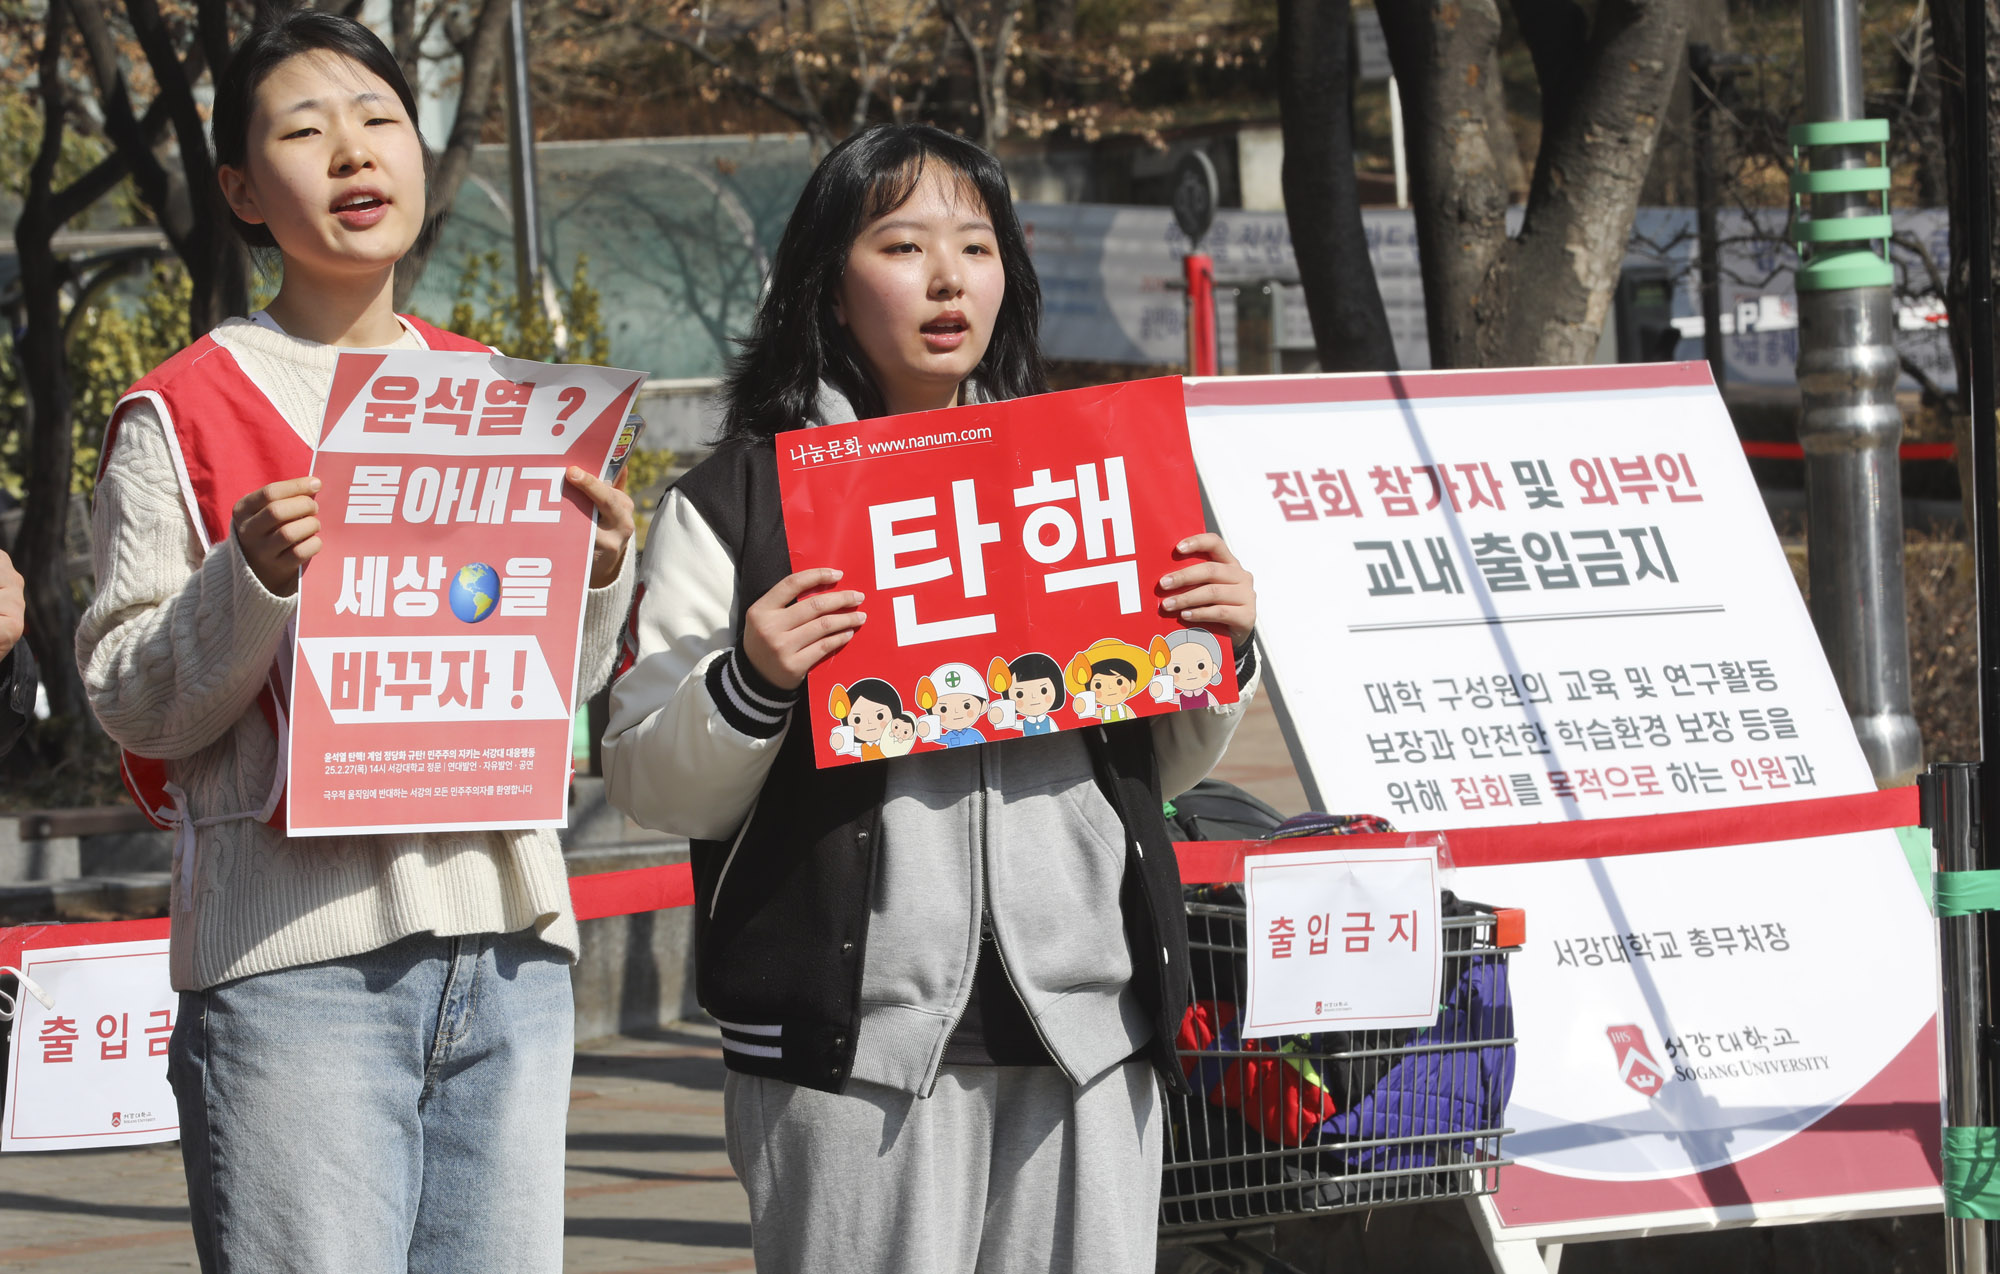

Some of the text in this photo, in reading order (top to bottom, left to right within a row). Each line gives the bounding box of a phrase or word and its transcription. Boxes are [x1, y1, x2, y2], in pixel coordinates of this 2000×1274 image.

[362, 375, 587, 437] 윤석열 ?
[790, 426, 992, 465] 나눔문화 www.nanum.com
[344, 465, 567, 525] 몰아내고
[1265, 453, 1704, 522] 집회 참가자 및 외부인
[868, 456, 1142, 647] 탄핵
[1353, 526, 1679, 596] 교내 출입금지
[334, 556, 553, 617] 세상 을
[329, 649, 528, 712] 바꾸자 !
[1364, 659, 1778, 714] 대학 구성원의 교육 및 연구활동
[324, 752, 347, 763] 윤석열
[348, 751, 366, 762] 탄핵!
[367, 751, 382, 762] 계엄
[383, 750, 406, 761] 정당화
[408, 750, 426, 760] 규탄!
[427, 749, 457, 760] 민주주의
[458, 748, 481, 759] 지키는
[482, 748, 505, 759] 서강대
[1366, 707, 1799, 764] 보장과 안전한 학습환경 보장 등을
[323, 784, 533, 800] 극우적 움직임에 반대하는 서강의 모든 민주주의자를 환영합니다
[325, 760, 534, 775] 25.2.27(목) 14시 서강대학교 정문 연대발언 자유발언 공연
[1386, 754, 1816, 814] 위해 집회를 목적으로 하는 인원과
[1553, 922, 1790, 967] 서강대학교 총무처장
[1611, 1031, 1631, 1044] IHS
[1664, 1025, 1800, 1059] 서강대학교
[1674, 1056, 1831, 1082] SOGANG UNIVERSITY
